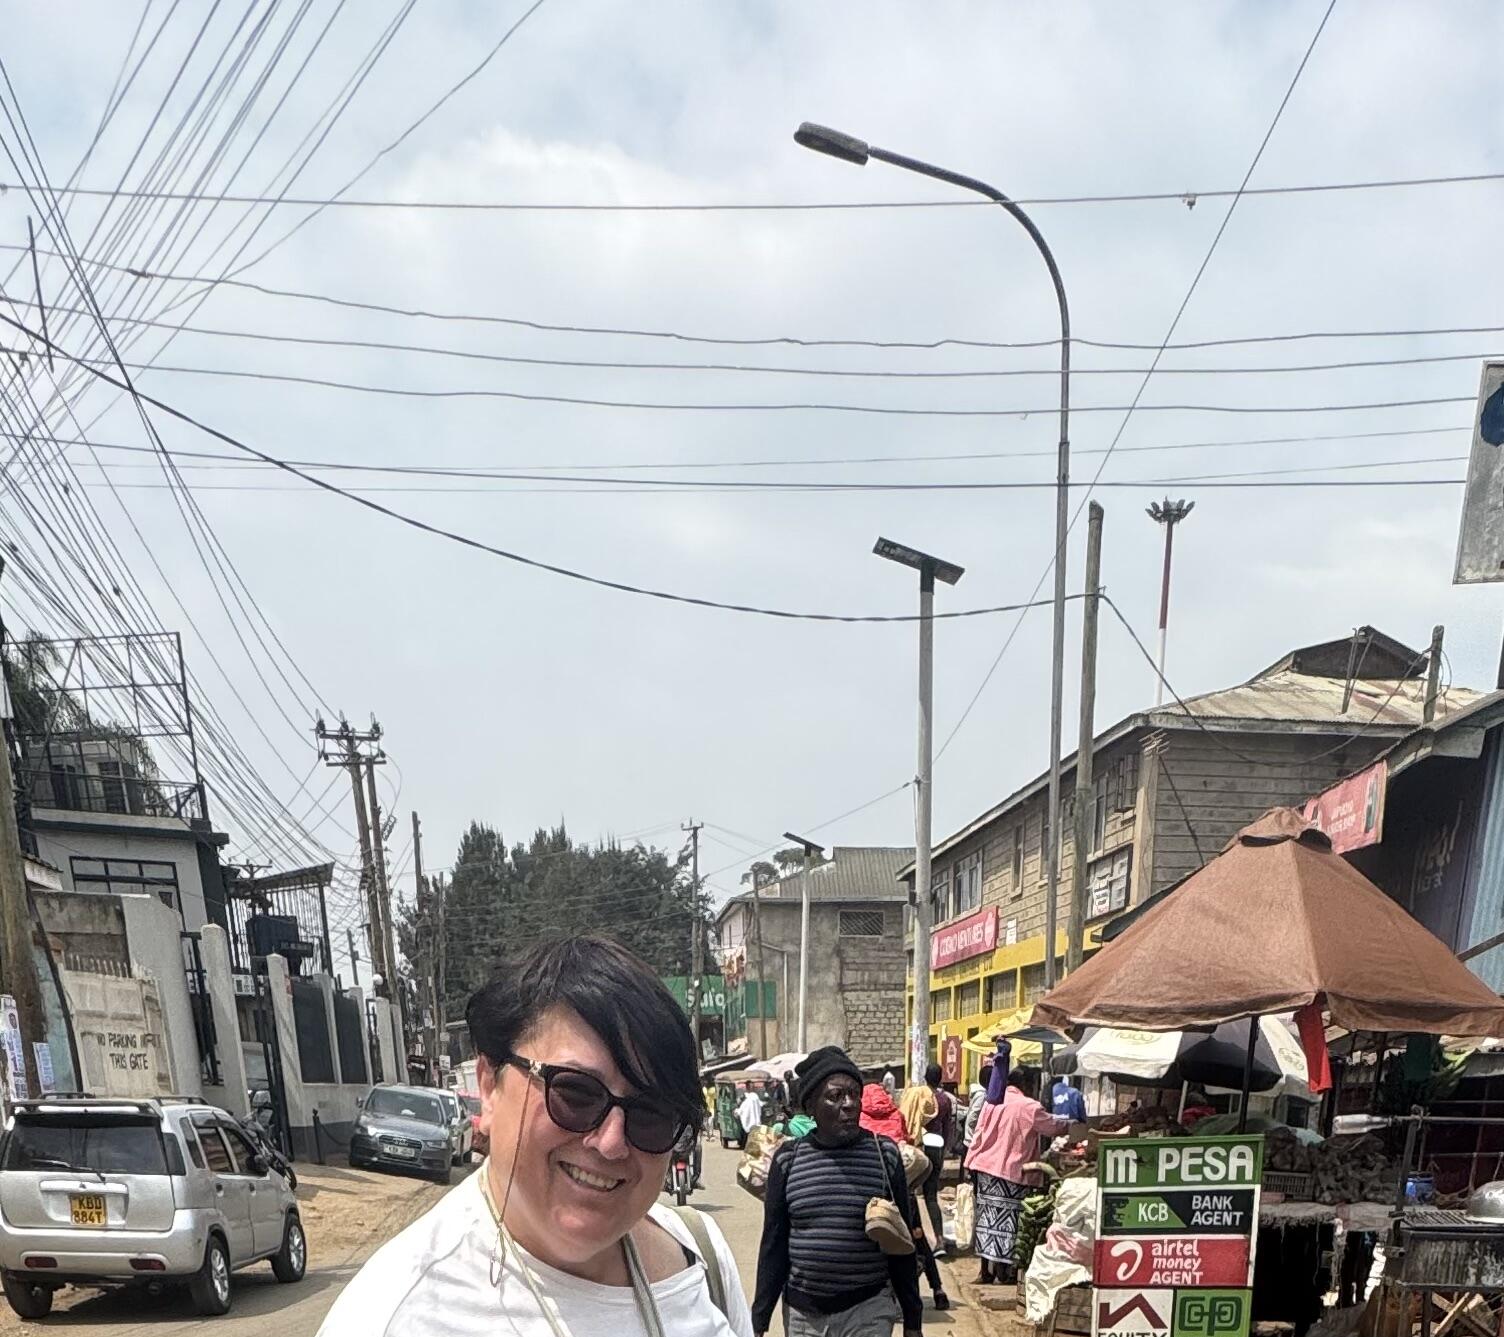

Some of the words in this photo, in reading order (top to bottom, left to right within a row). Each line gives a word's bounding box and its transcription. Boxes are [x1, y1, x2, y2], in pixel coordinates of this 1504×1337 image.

[107, 1032, 137, 1048] PARKING
[109, 1053, 127, 1069] THIS
[129, 1053, 149, 1070] GATE
[1157, 1145, 1254, 1182] PESA
[1191, 1195, 1233, 1210] BANK
[1137, 1202, 1169, 1222] KCB
[1190, 1211, 1244, 1227] AGENT
[1151, 1239, 1200, 1256] airtel
[1152, 1257, 1202, 1272] money
[1149, 1271, 1204, 1286] AGENT
